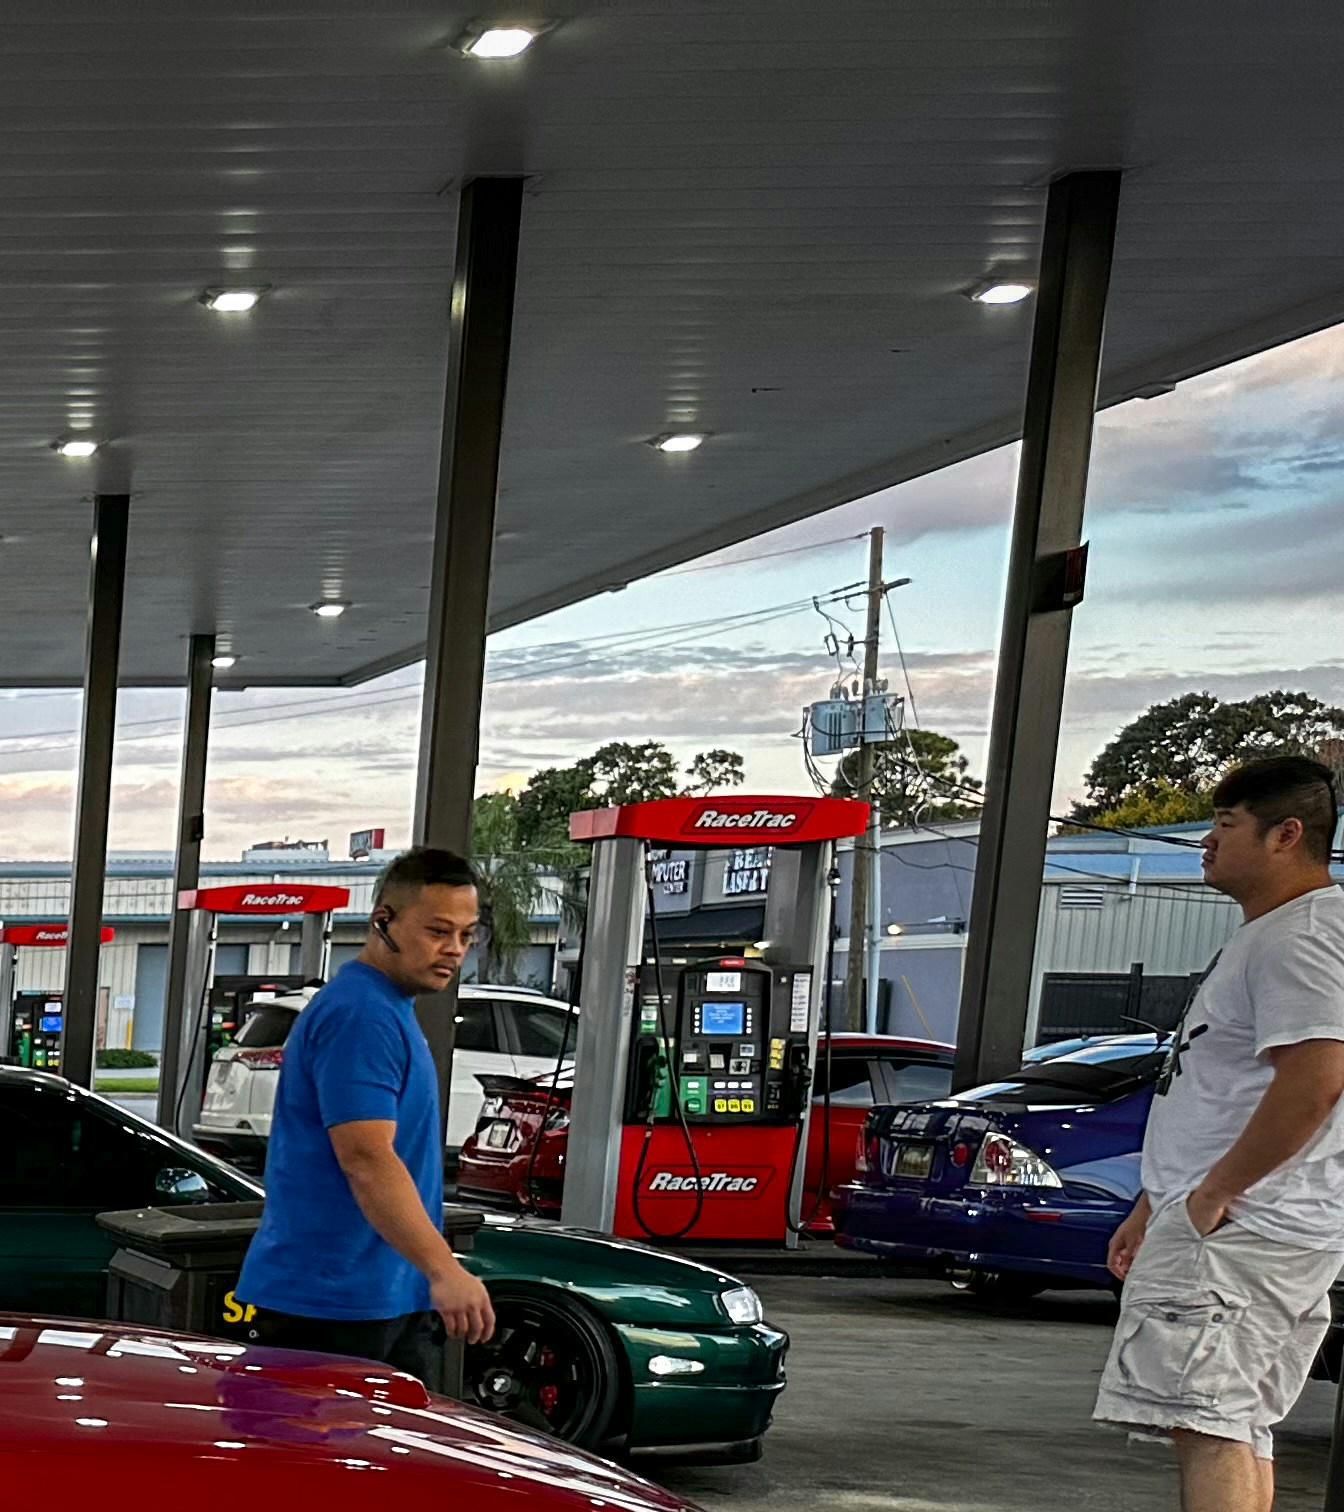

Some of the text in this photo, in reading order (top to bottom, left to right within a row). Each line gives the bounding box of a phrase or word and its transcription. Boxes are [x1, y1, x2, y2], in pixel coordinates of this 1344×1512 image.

[694, 810, 796, 828] RaceTrac
[241, 893, 304, 906] RaceTrac
[648, 1172, 758, 1191] RaceTrac
